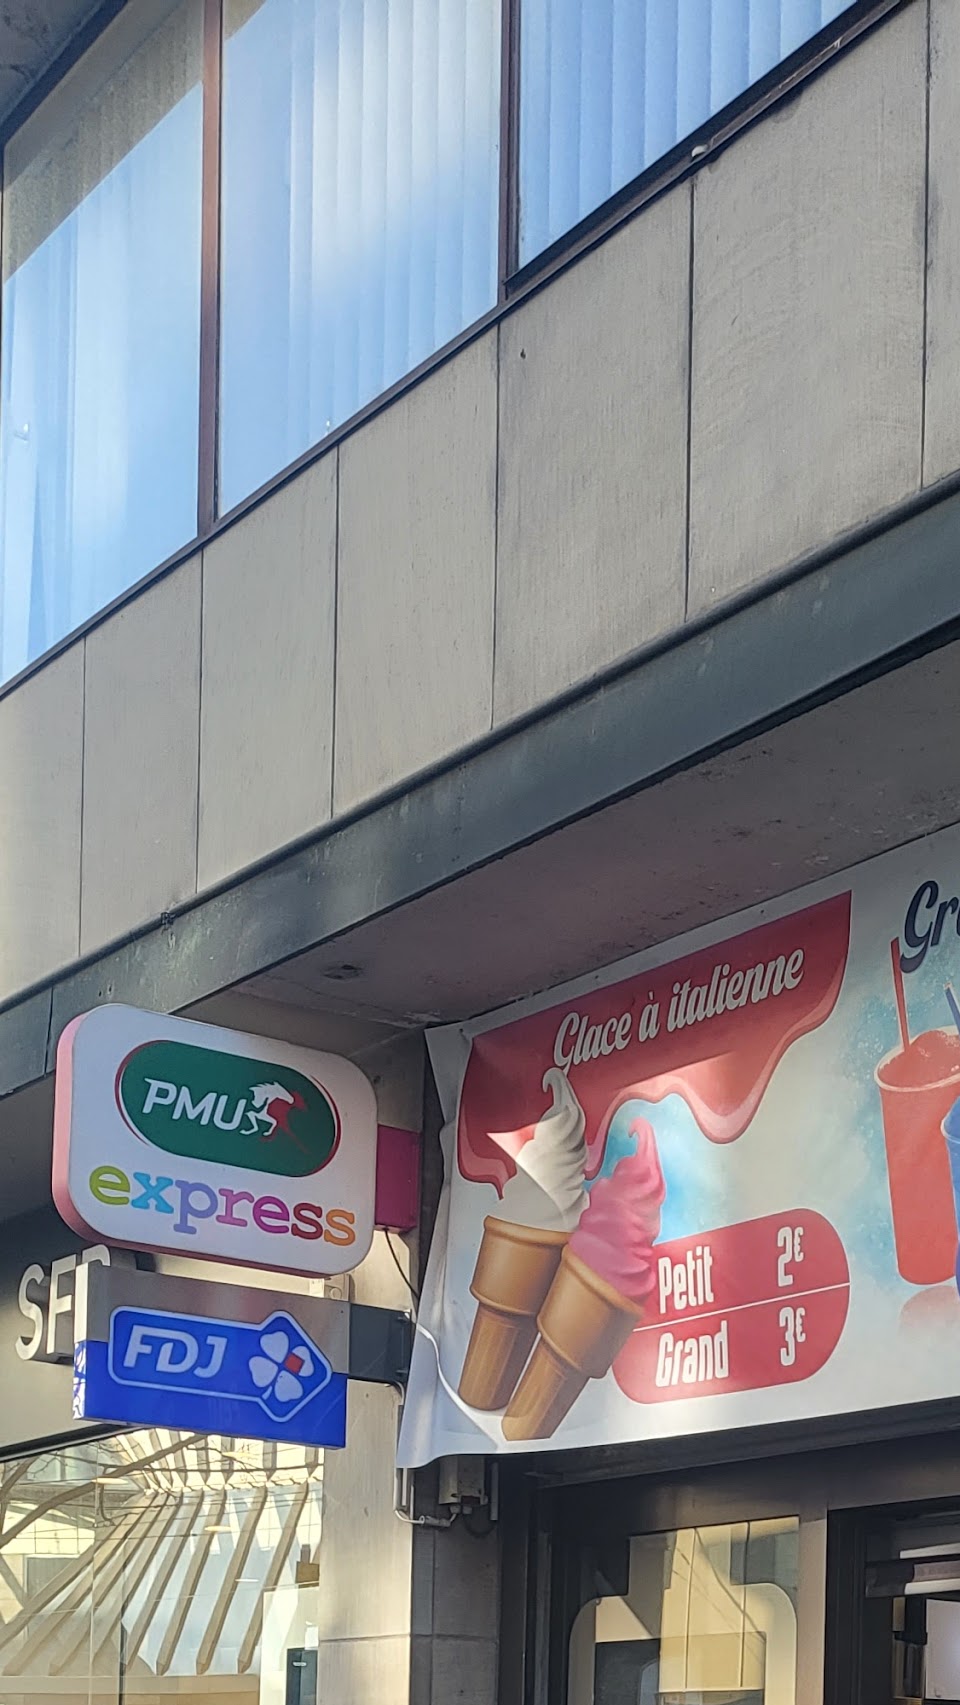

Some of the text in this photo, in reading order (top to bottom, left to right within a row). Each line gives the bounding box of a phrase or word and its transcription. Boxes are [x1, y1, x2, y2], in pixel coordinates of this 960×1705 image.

[552, 946, 806, 1074] Glace à italienne
[142, 1077, 248, 1131] PMU
[89, 1165, 357, 1247] express
[14, 1244, 111, 1362] SF
[658, 1226, 804, 1315] Petit 2€
[122, 1324, 228, 1379] FDJ
[655, 1306, 806, 1389] Grand 3€
